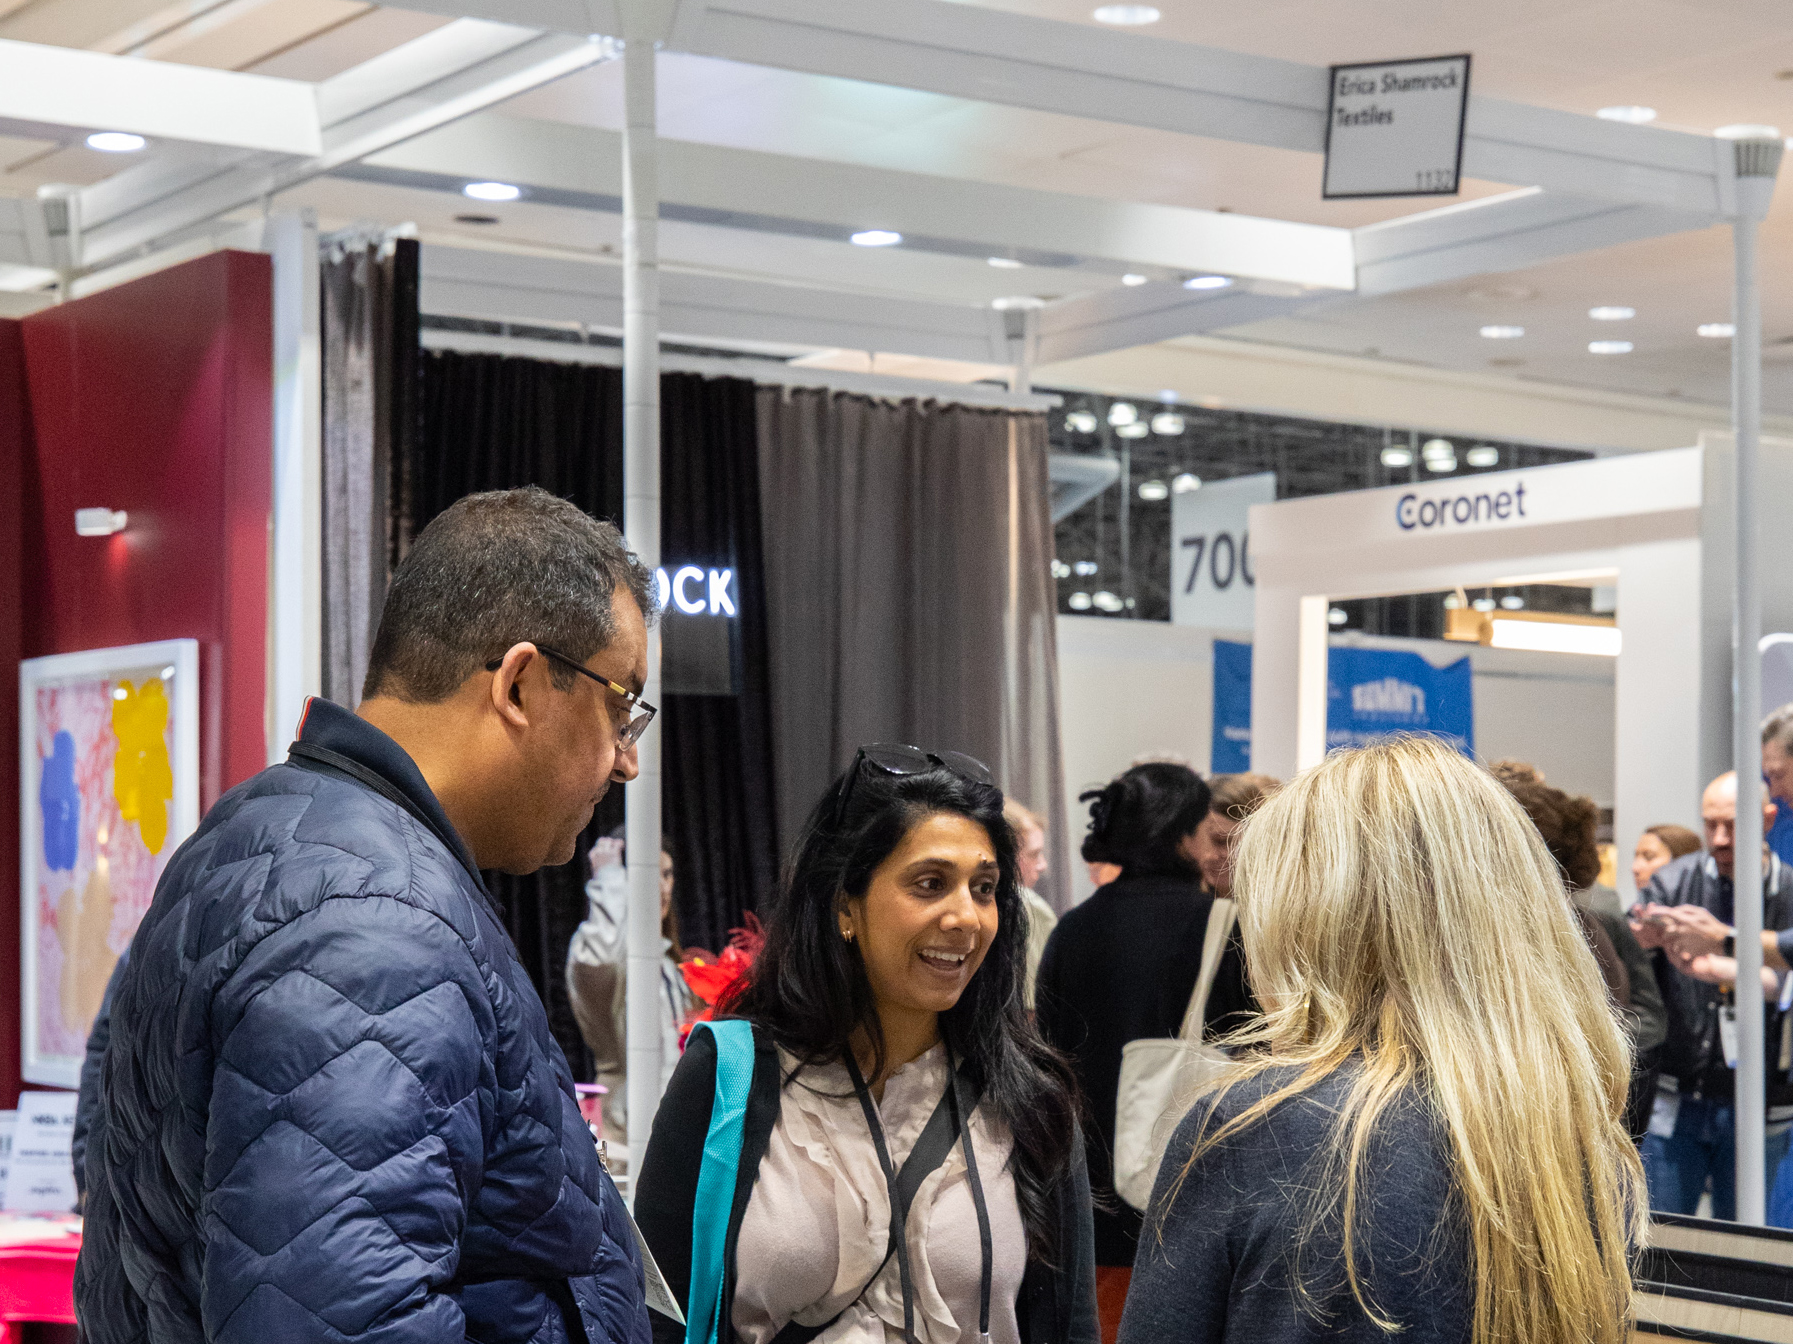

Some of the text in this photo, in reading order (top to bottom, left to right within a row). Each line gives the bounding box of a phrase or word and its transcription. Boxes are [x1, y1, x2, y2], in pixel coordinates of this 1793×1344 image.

[1339, 68, 1457, 97] Erica Shamrock
[1396, 481, 1526, 531] Coronet
